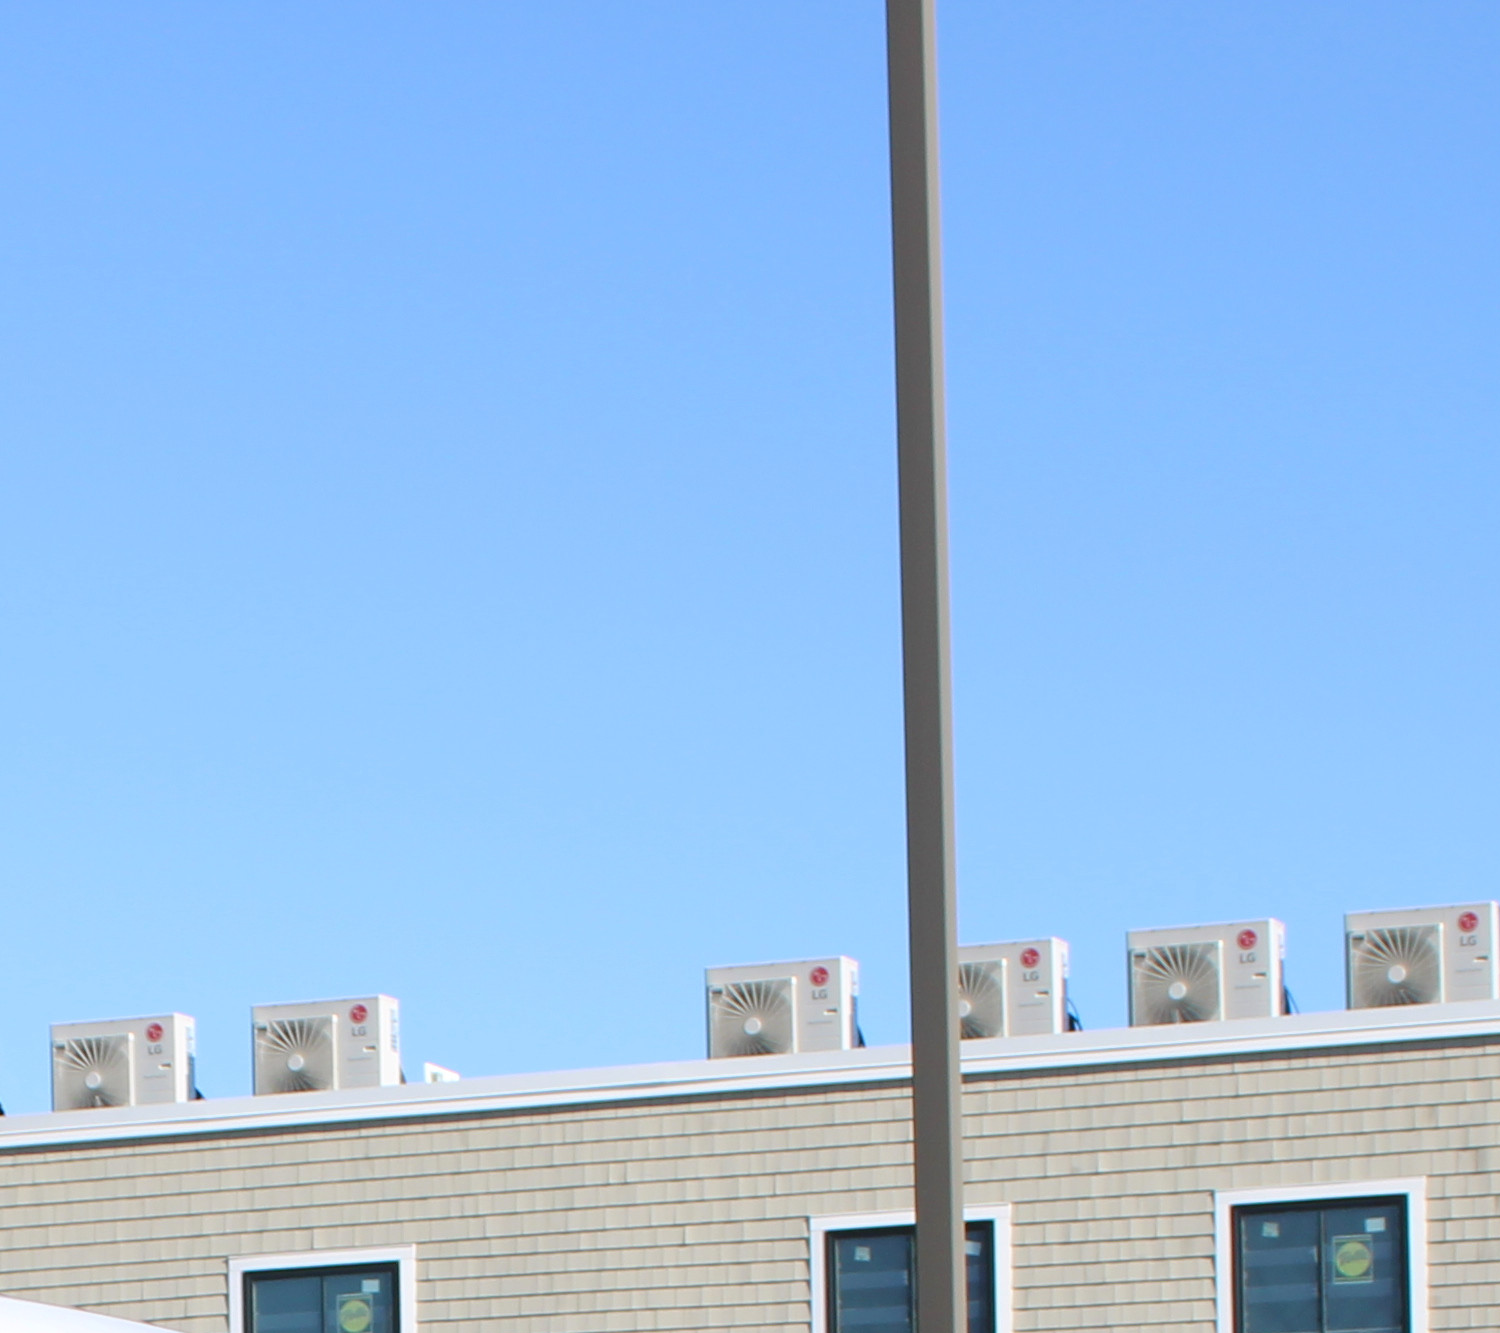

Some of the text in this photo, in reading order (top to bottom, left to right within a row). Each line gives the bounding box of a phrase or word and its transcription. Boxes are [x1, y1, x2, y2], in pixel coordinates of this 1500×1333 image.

[1460, 935, 1477, 946] LG
[1239, 952, 1256, 964] LG
[1023, 971, 1039, 982] LG
[812, 989, 827, 1000] LG
[352, 1025, 366, 1037] LG
[147, 1044, 162, 1055] LG
